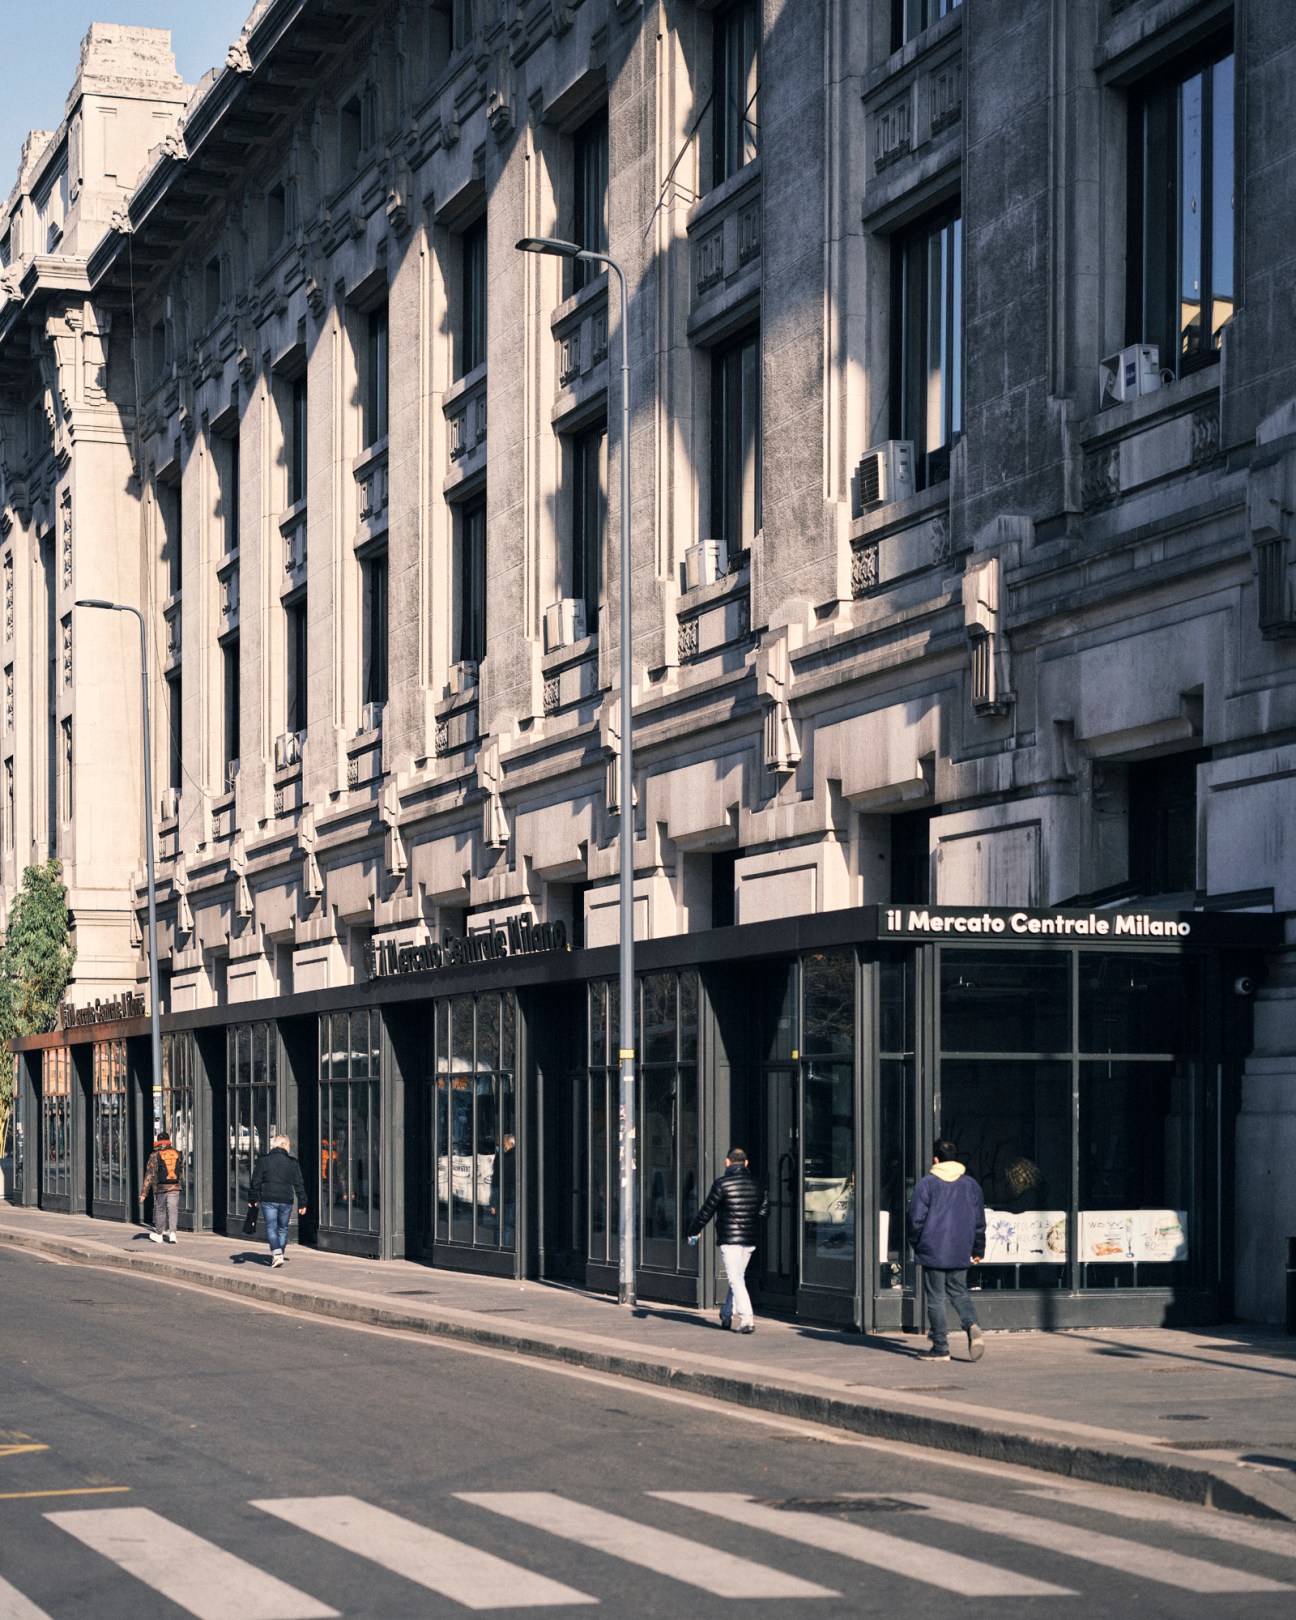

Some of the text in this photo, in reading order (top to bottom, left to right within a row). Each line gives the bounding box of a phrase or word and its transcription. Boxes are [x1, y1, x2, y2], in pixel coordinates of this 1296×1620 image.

[507, 912, 567, 955] Milano
[887, 909, 1191, 936] il Mercato Centrale Milano
